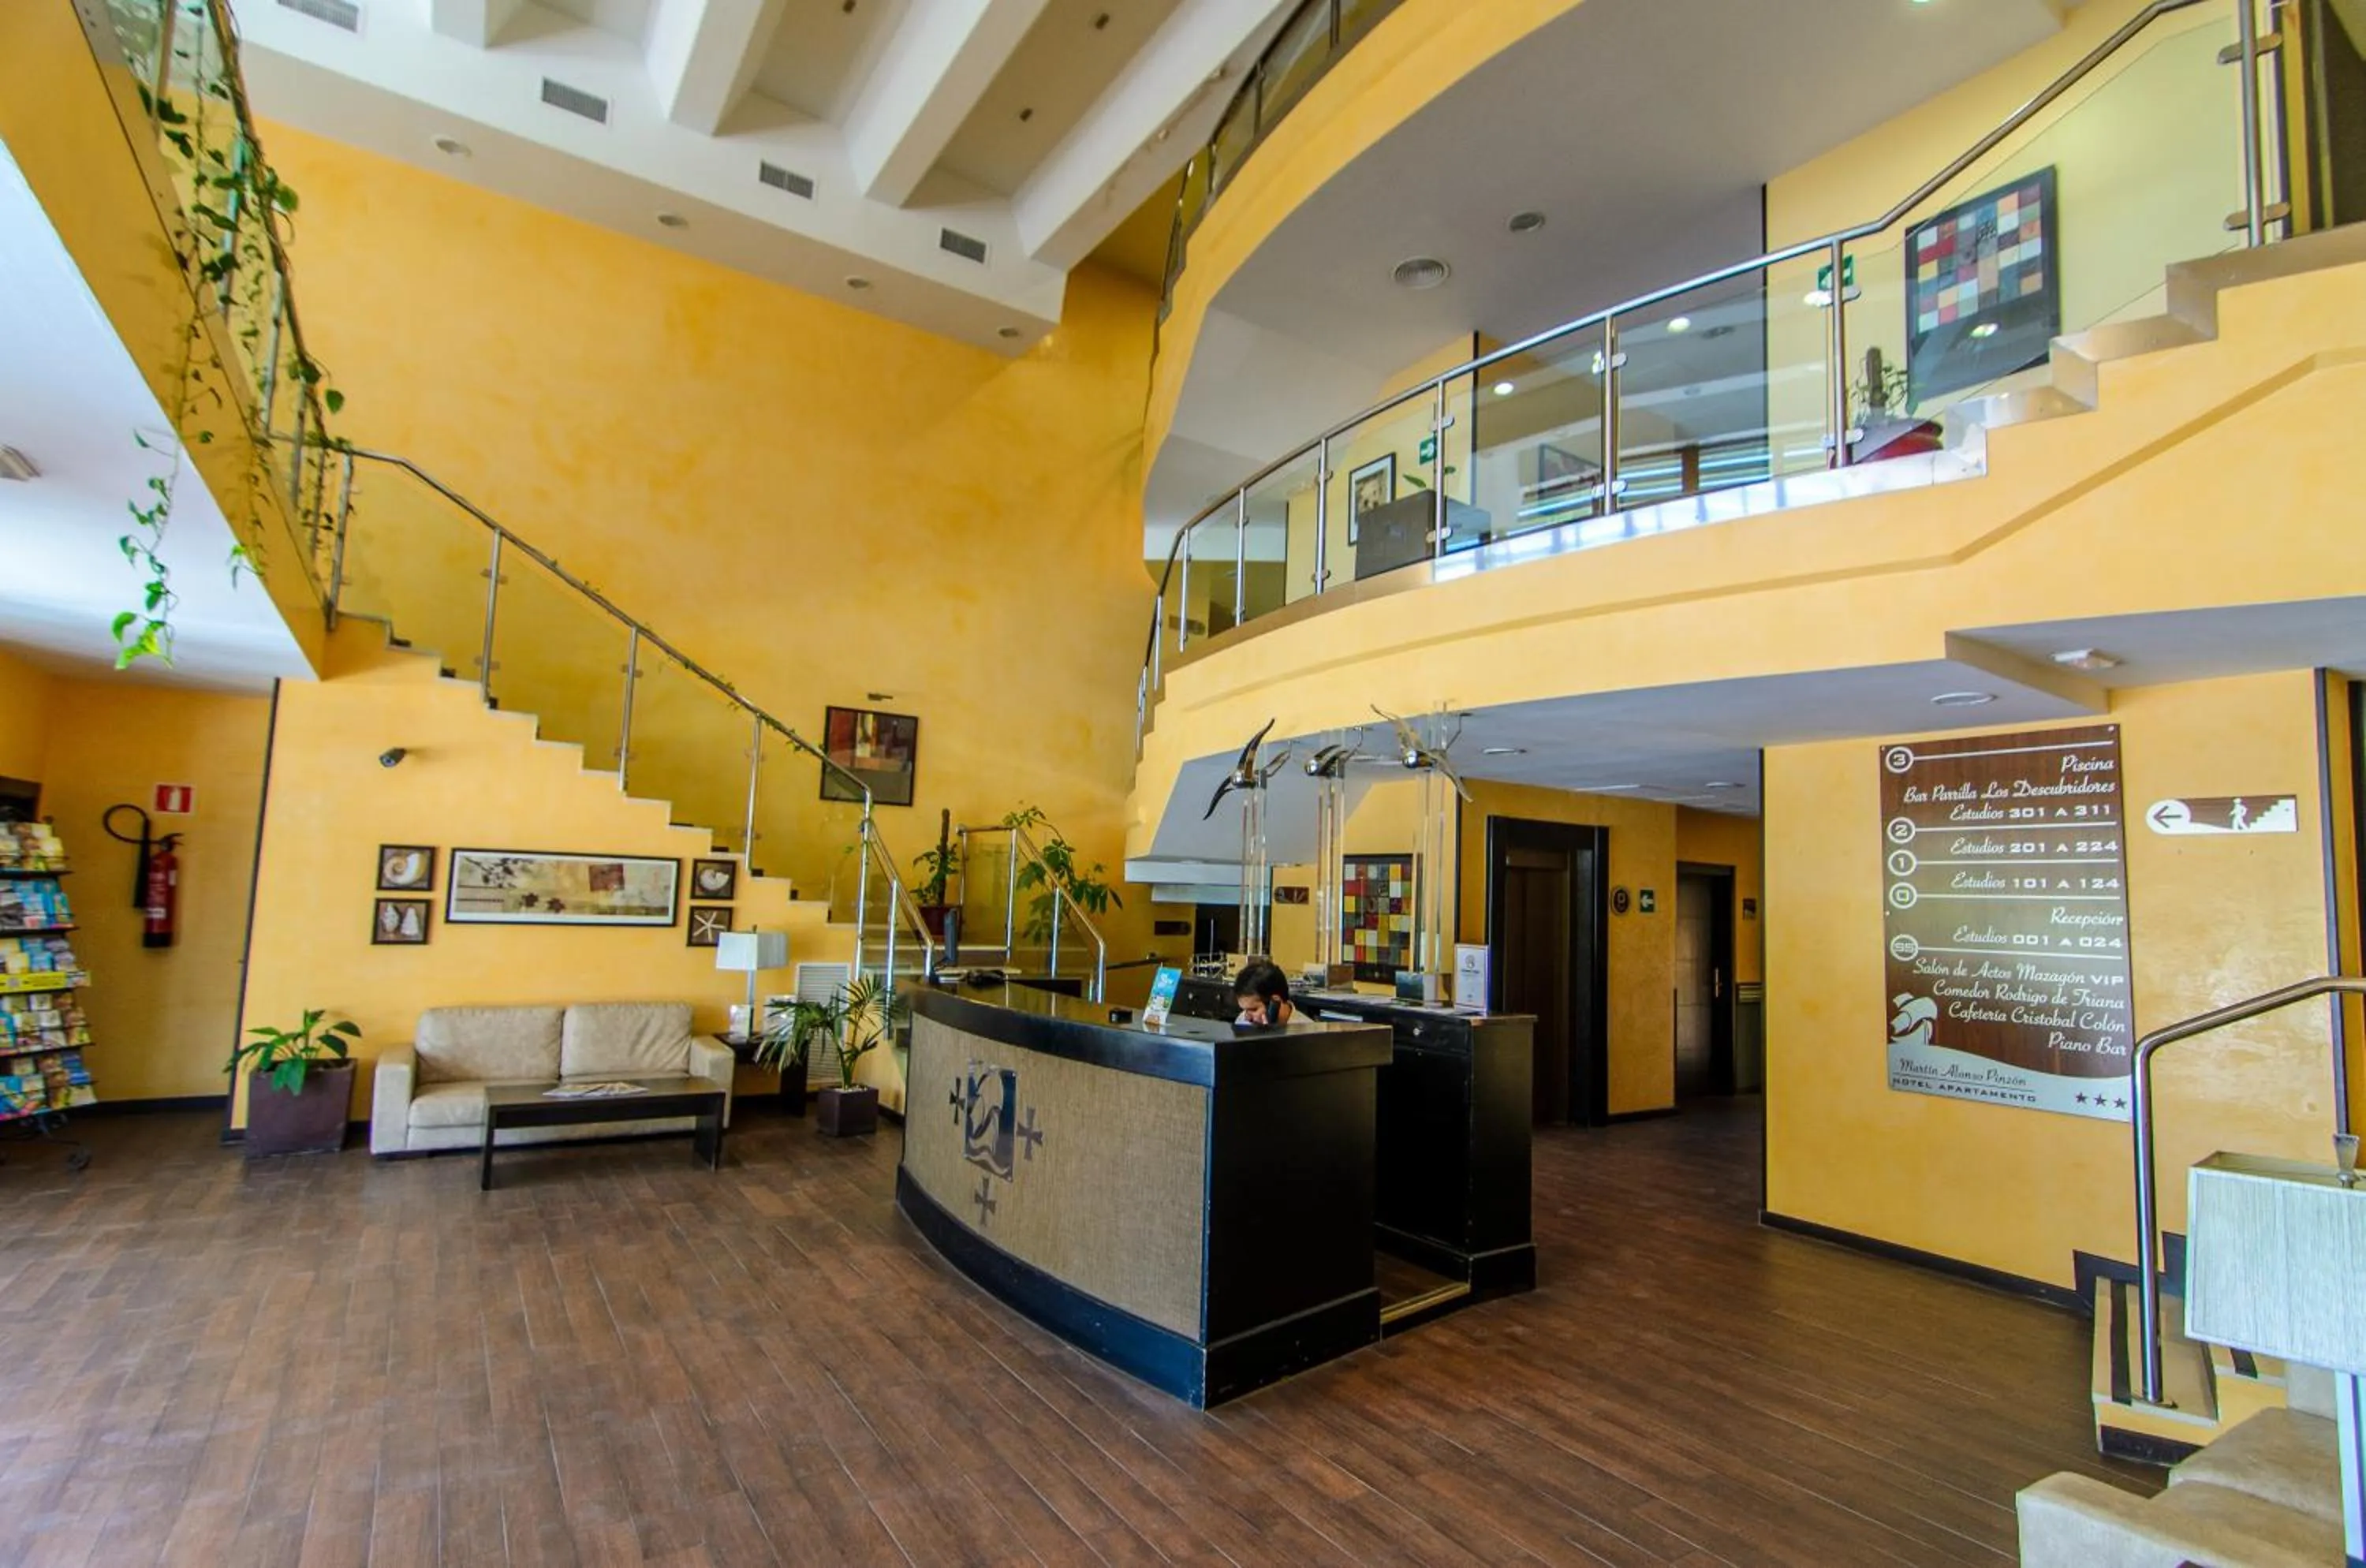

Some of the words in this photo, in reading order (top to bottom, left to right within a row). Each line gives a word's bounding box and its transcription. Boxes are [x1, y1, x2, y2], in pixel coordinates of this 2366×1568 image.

[1893, 753, 1906, 766] 3
[2061, 755, 2114, 773] Piscina
[1904, 786, 1928, 803] Bar
[1932, 783, 1977, 801] Parrilla
[1980, 782, 2009, 799] Los
[2012, 775, 2115, 797] Descubridores
[1950, 803, 2004, 821] Estudios
[2009, 807, 2045, 818] 301
[2055, 807, 2068, 817] A
[2074, 805, 2110, 816] 311
[1895, 824, 1908, 836] 2
[1950, 835, 2004, 854] Estudios
[2010, 842, 2045, 853] 201
[2056, 842, 2069, 853] A
[2075, 842, 2118, 853] 224
[1898, 857, 1904, 868] 1
[1950, 870, 2006, 890] Estudios
[2013, 878, 2047, 889] 101
[2057, 878, 2069, 889] A
[2080, 878, 2120, 889] 124
[1953, 924, 2008, 944] Estudios
[2013, 934, 2048, 945] 001
[2058, 937, 2073, 946] A
[2079, 936, 2122, 948] 024
[1953, 959, 1968, 976] de
[1971, 961, 2011, 979] Actos
[2017, 963, 2084, 985] Mazagón
[2091, 975, 2124, 985] VIP
[1933, 979, 1990, 999] Comedor
[1995, 984, 2047, 1006] Rodrigo
[2051, 986, 2068, 1005] de
[2073, 988, 2125, 1009] Triana
[2011, 1006, 2077, 1028] Cristobal
[2049, 1031, 2091, 1052] Piano
[2095, 1036, 2127, 1055] Bar
[1941, 1064, 1983, 1081] Alonso
[1893, 1077, 1932, 1089] HOTEL
[1939, 1084, 2036, 1103] APARTAMENTO
